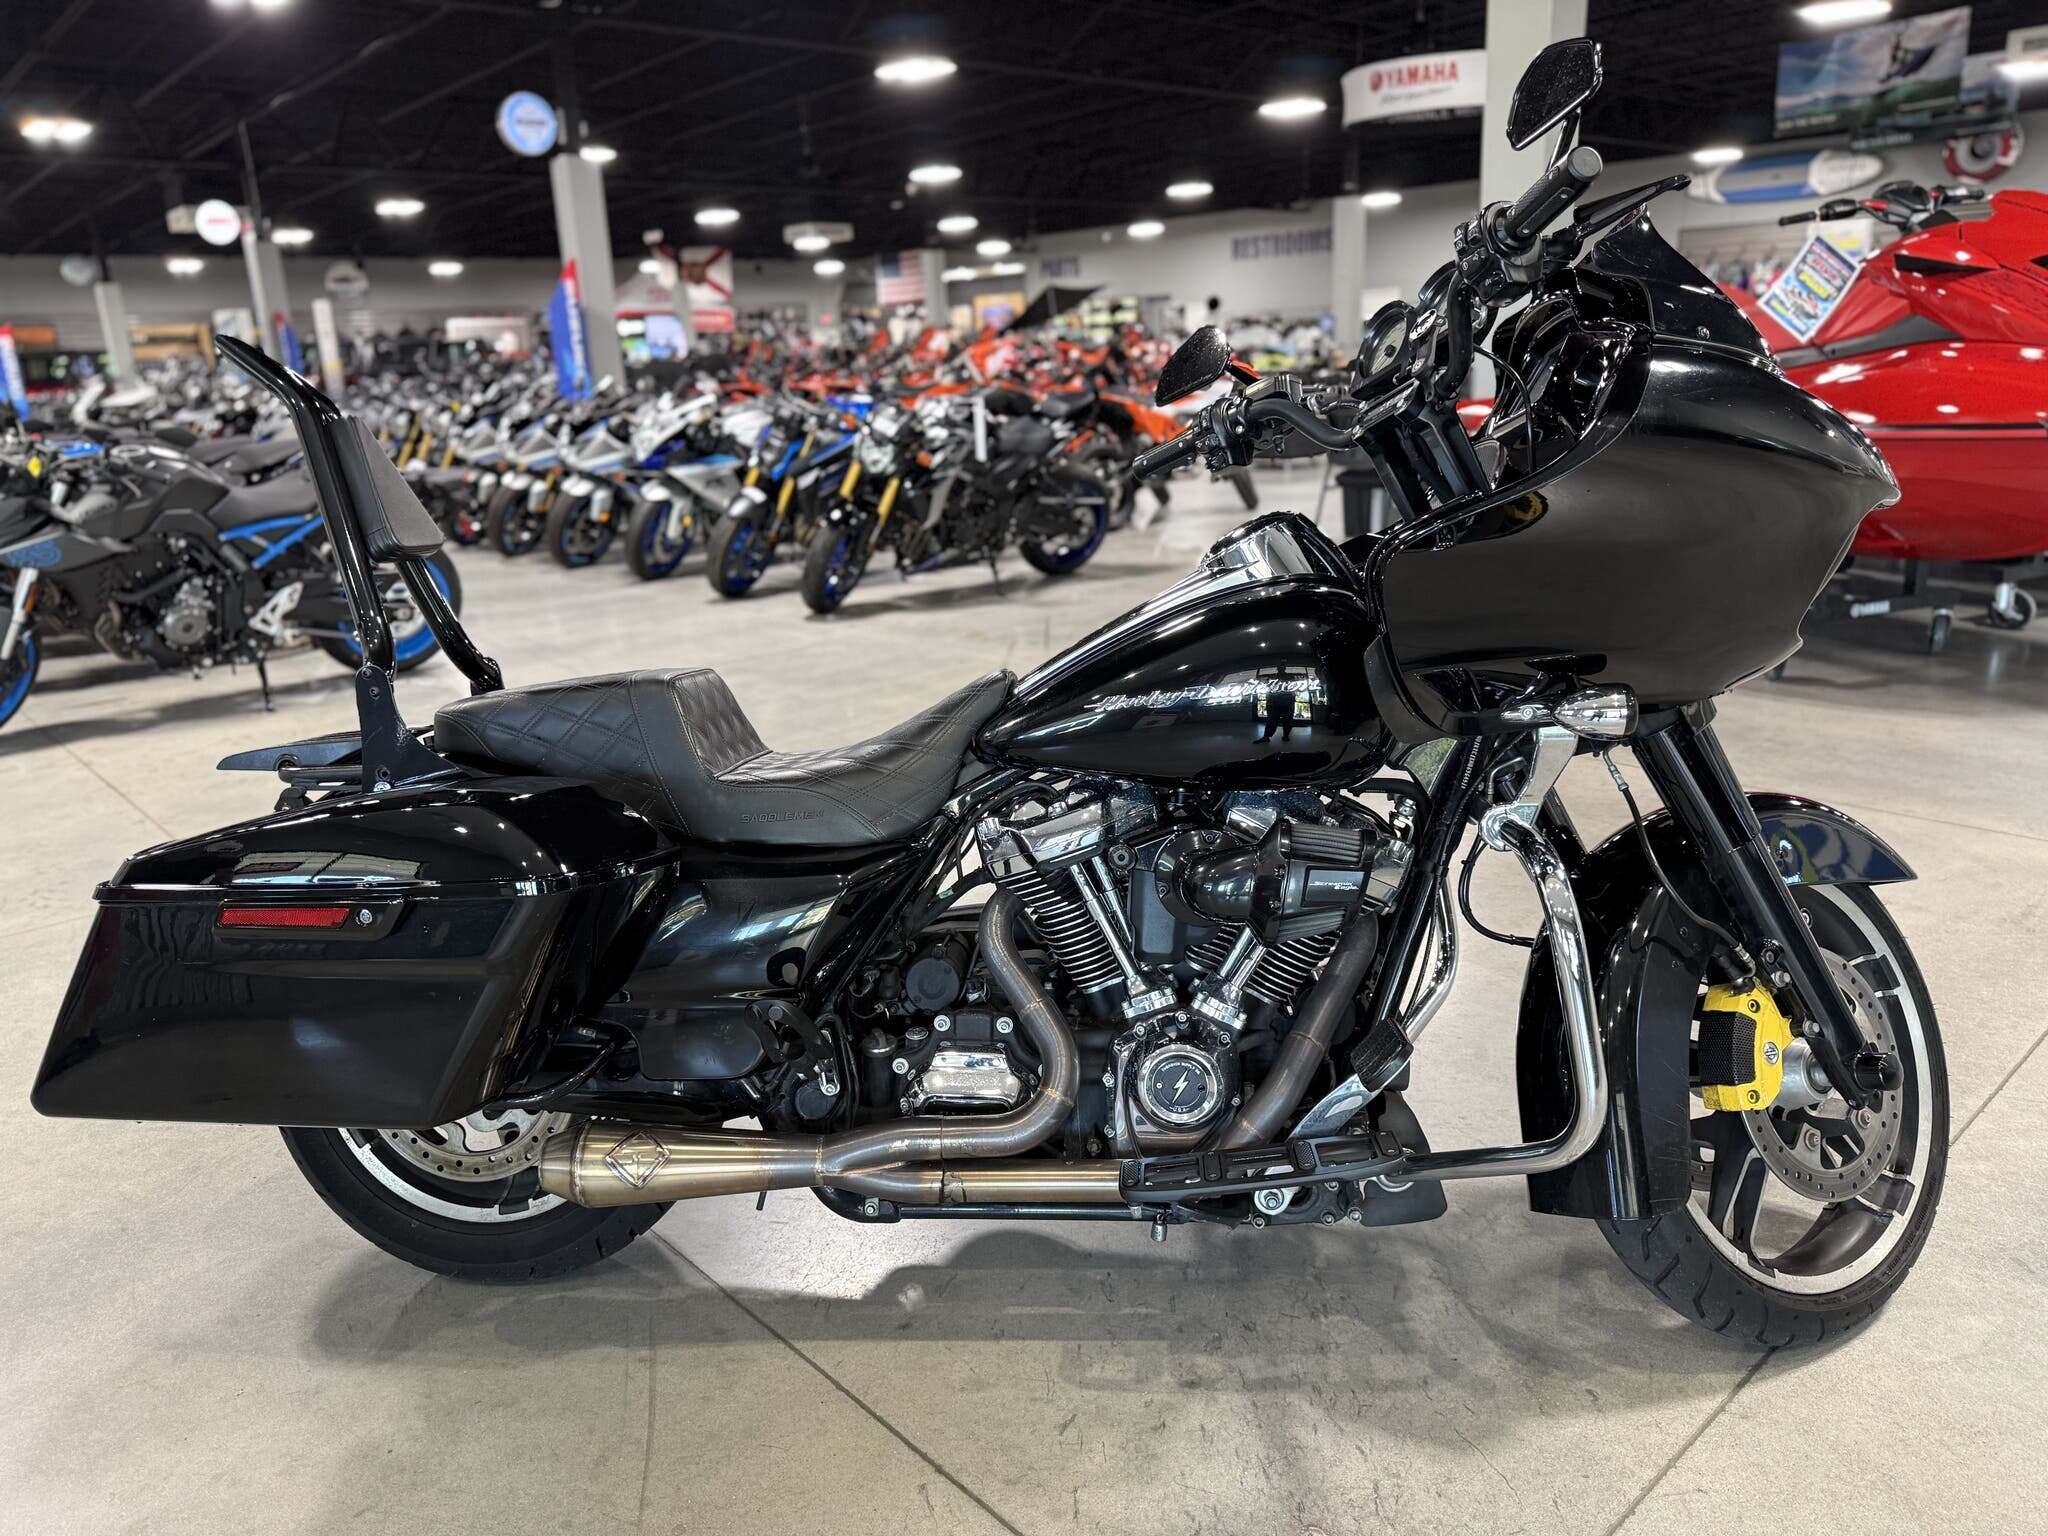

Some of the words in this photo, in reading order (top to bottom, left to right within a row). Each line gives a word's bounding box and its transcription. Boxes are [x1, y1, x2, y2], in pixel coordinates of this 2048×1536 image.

[1386, 59, 1459, 89] YAMAHA
[1084, 679, 1321, 711] Harley-Davidson
[740, 809, 825, 824] SADDLEMEN
